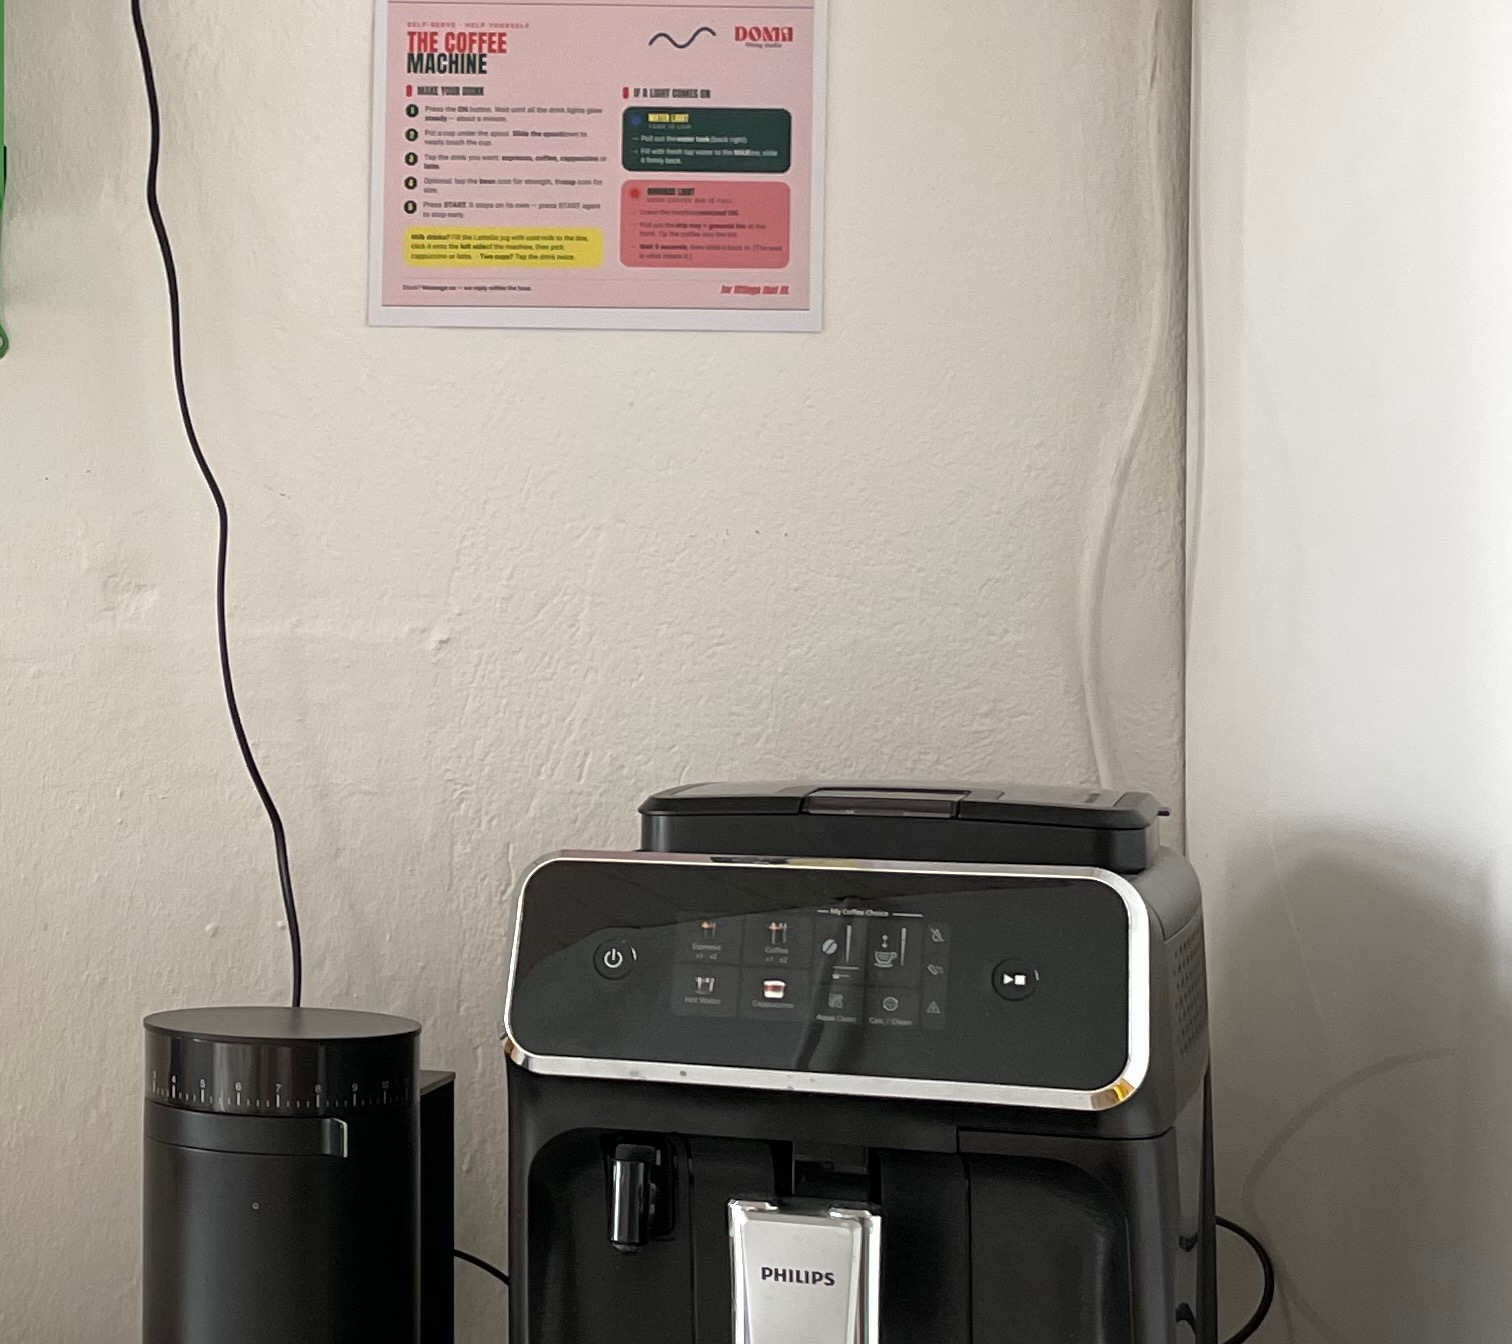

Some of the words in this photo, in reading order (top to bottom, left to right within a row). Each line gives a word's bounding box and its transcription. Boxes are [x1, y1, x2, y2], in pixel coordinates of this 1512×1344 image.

[407, 31, 438, 52] THE
[445, 32, 506, 53] COFFEE
[407, 53, 487, 74] MACHINE
[172, 1075, 176, 1083] 4
[276, 1084, 281, 1092] 7
[761, 1267, 835, 1286] PHILIPS
